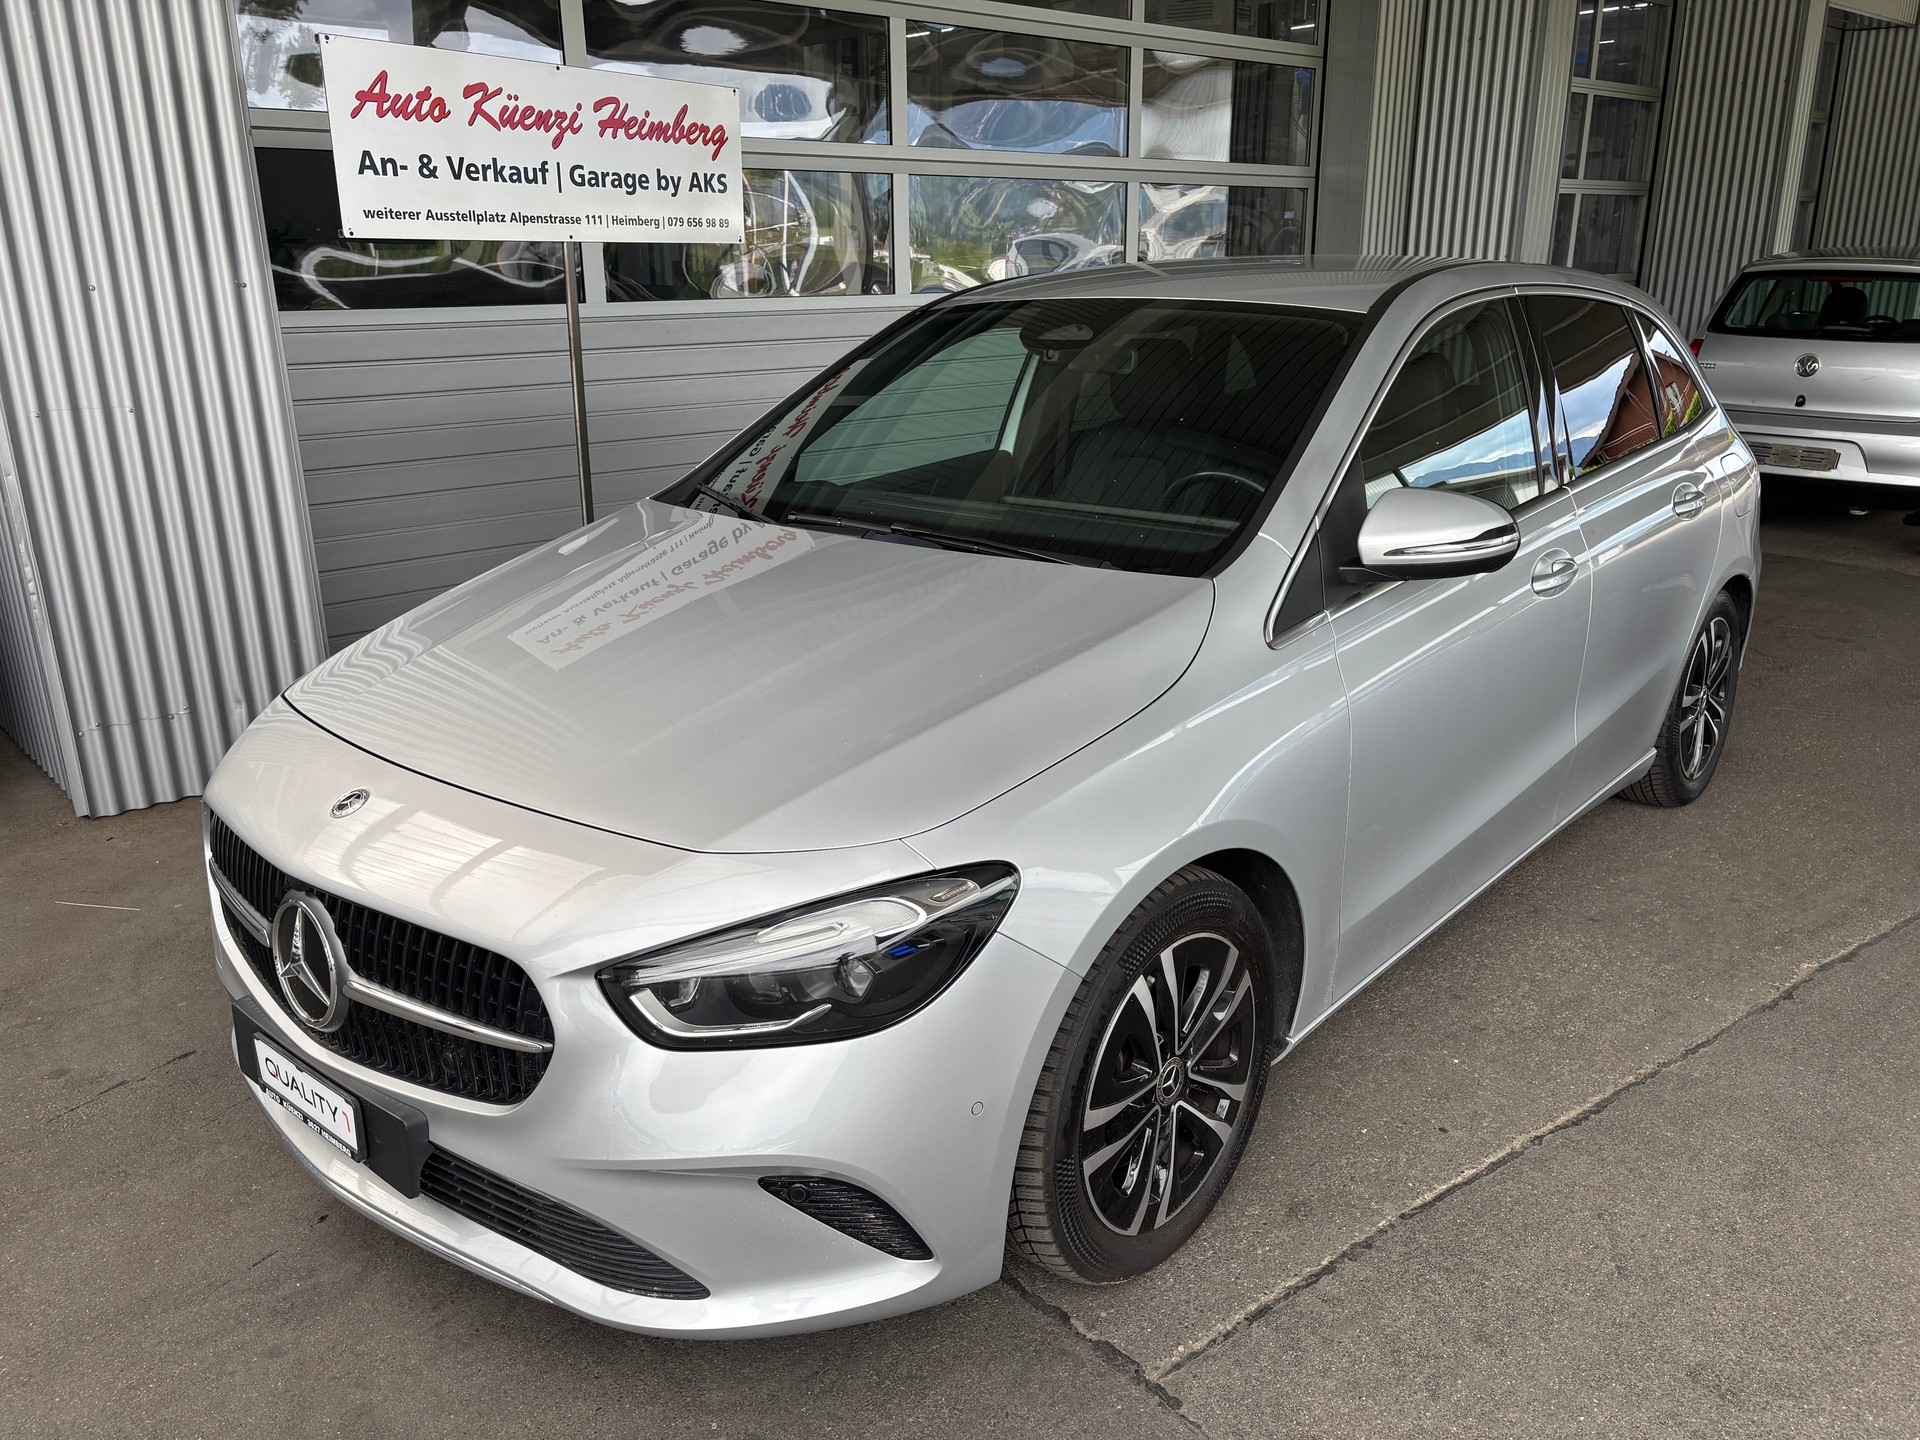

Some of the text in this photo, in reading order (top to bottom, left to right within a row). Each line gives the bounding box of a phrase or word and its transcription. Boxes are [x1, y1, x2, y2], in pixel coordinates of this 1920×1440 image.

[350, 70, 729, 161] Auto Küenzi Heimberg
[358, 150, 408, 177] An-
[418, 154, 439, 179] &
[446, 156, 549, 185] Verkauf
[569, 164, 650, 195] Garage
[656, 168, 682, 197] by
[688, 172, 728, 194] AKS
[363, 207, 421, 221] weiterer
[426, 209, 506, 225] Ausstellplatz
[510, 212, 582, 226] Alpenstrasse
[585, 214, 603, 226] 111
[611, 216, 660, 229] Heimberg
[667, 217, 684, 227] 079
[687, 218, 703, 228] 656
[706, 218, 717, 228] 98
[719, 218, 730, 228] 89
